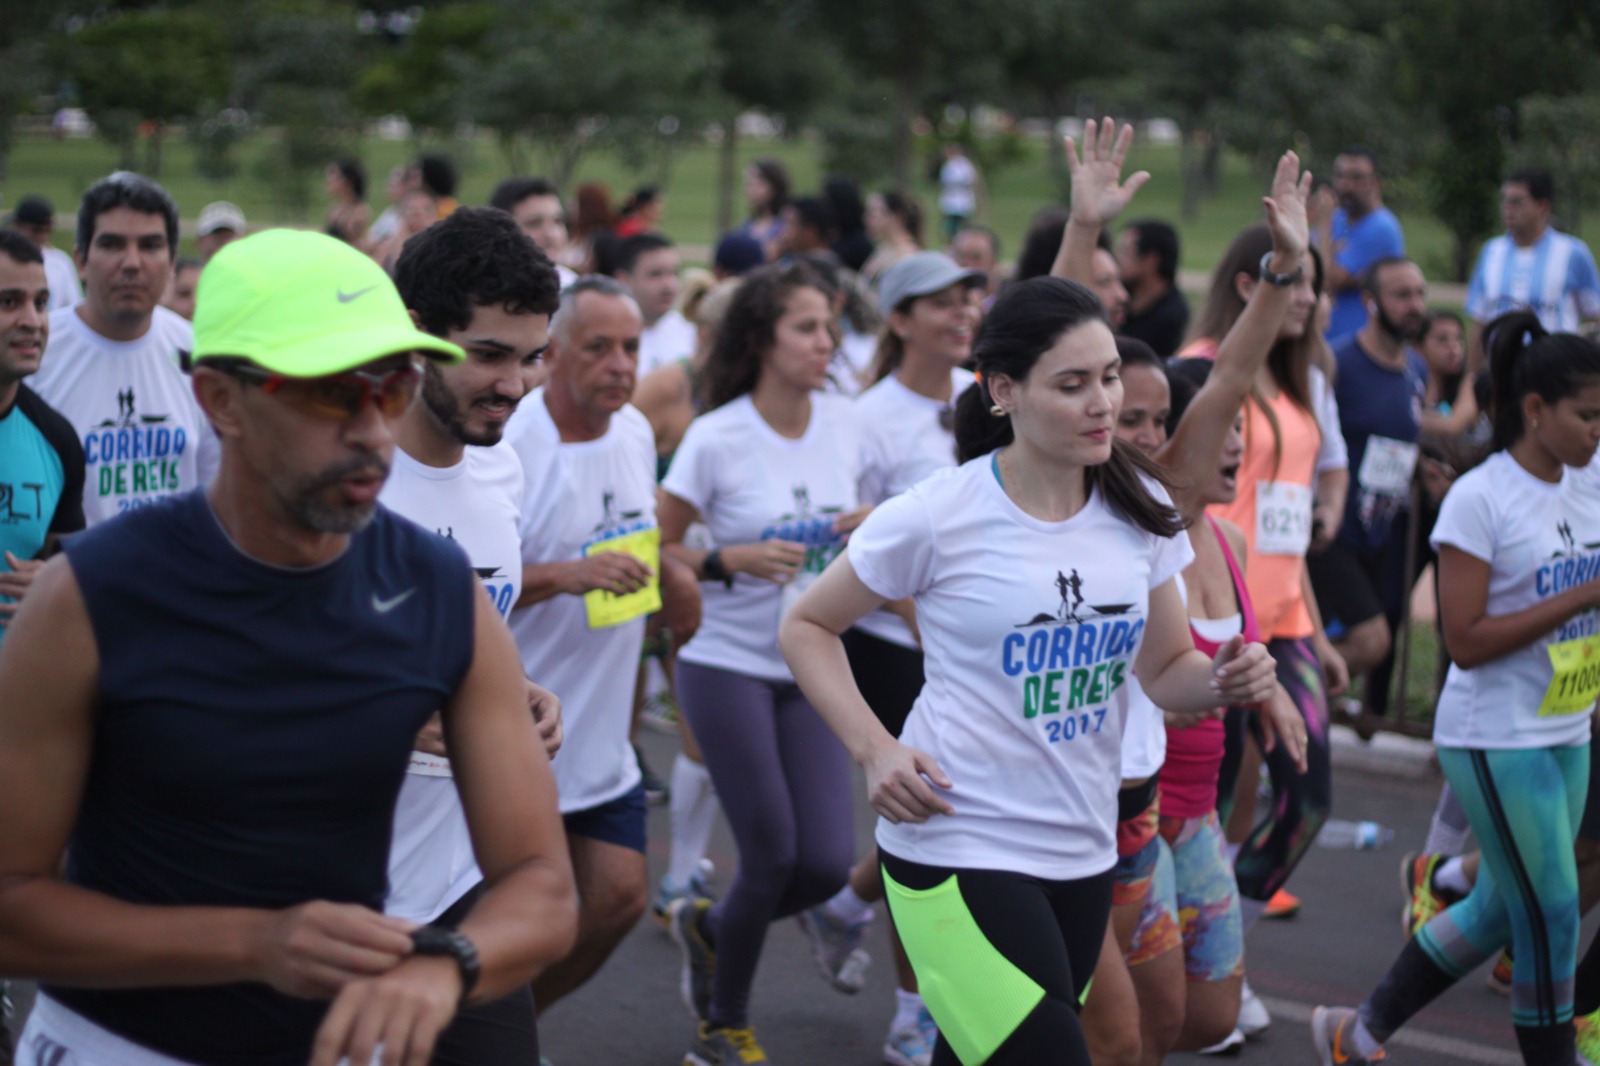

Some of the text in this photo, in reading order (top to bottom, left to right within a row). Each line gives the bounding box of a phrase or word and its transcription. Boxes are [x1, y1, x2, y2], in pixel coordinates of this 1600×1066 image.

[84, 426, 187, 464] CORRIDA
[99, 458, 180, 497] DE REIS
[1023, 659, 1127, 719] DE REIS
[1045, 707, 1108, 743] 2017
